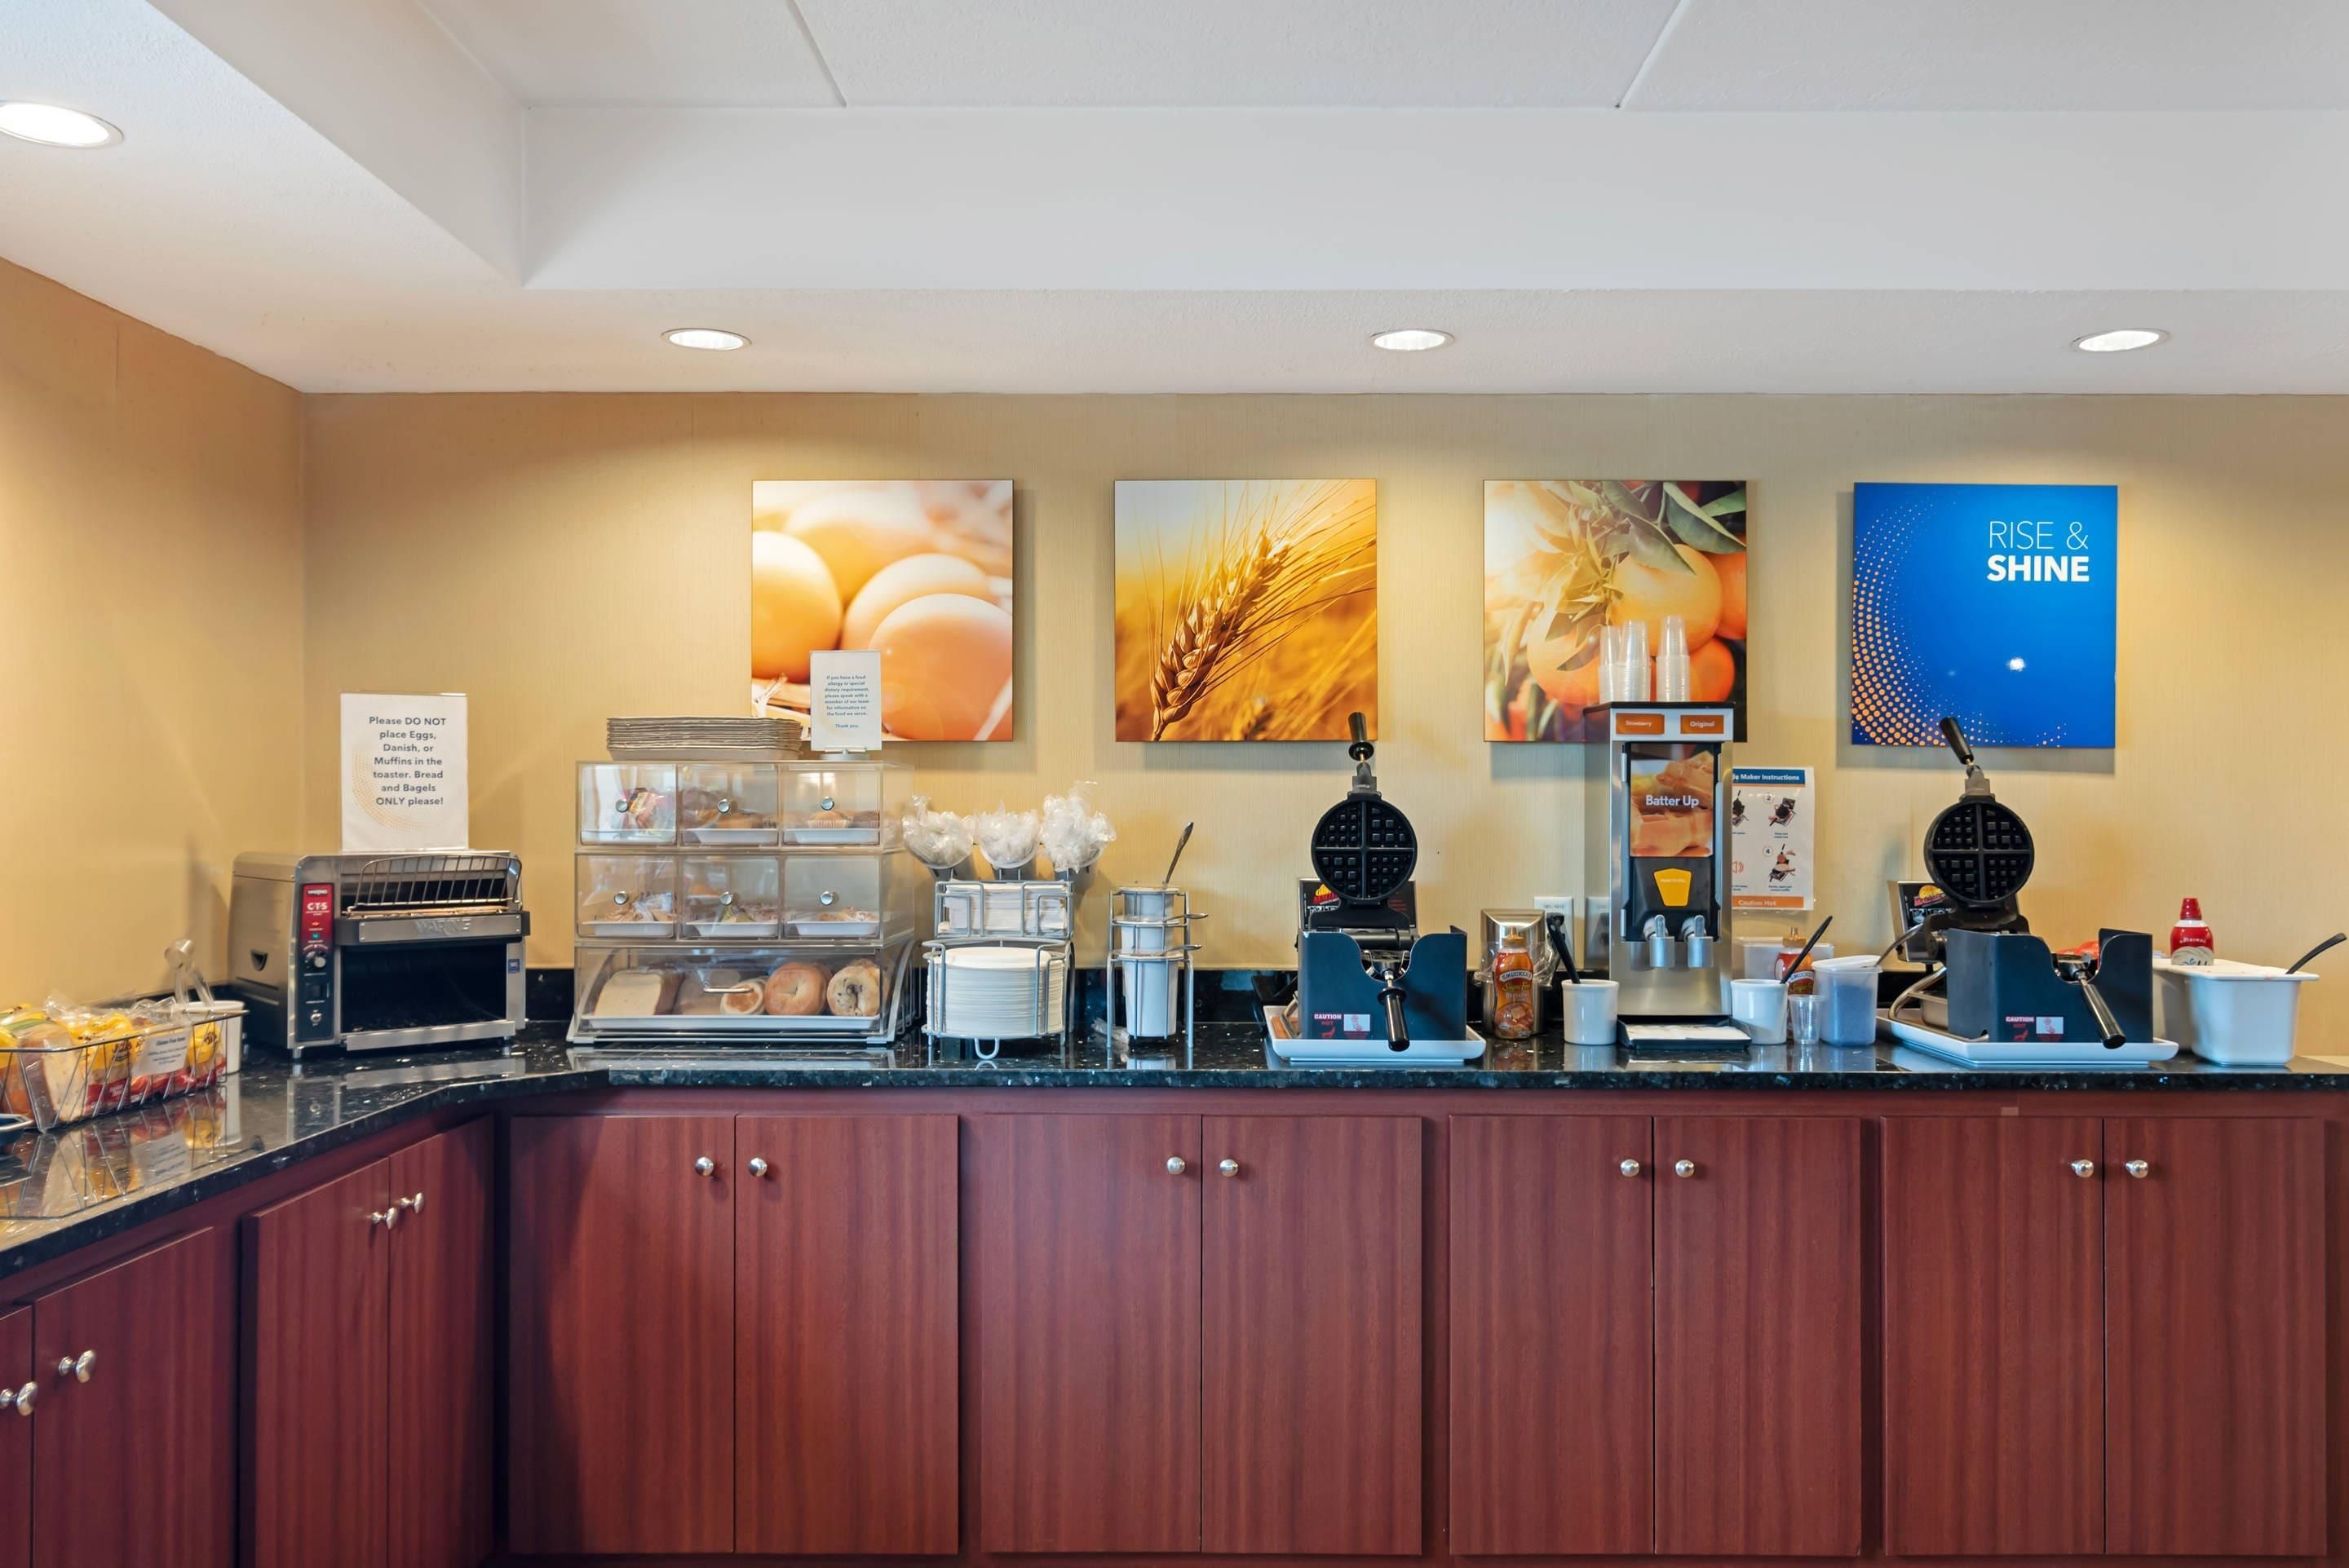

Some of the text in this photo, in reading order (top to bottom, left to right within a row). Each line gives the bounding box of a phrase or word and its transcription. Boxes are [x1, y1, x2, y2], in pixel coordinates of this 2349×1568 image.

[1989, 520, 2089, 550] RISE &
[1987, 554, 2090, 582] SHINE
[369, 717, 402, 725] Please
[424, 718, 447, 726] NOT
[379, 731, 436, 740] place Eggs,
[383, 744, 421, 753] Danish,
[374, 757, 412, 765] Muffins
[414, 771, 444, 779] Bread
[381, 784, 436, 793] and Bagels
[375, 797, 444, 806] ONLY please!
[1645, 795, 1699, 808] Batter Up
